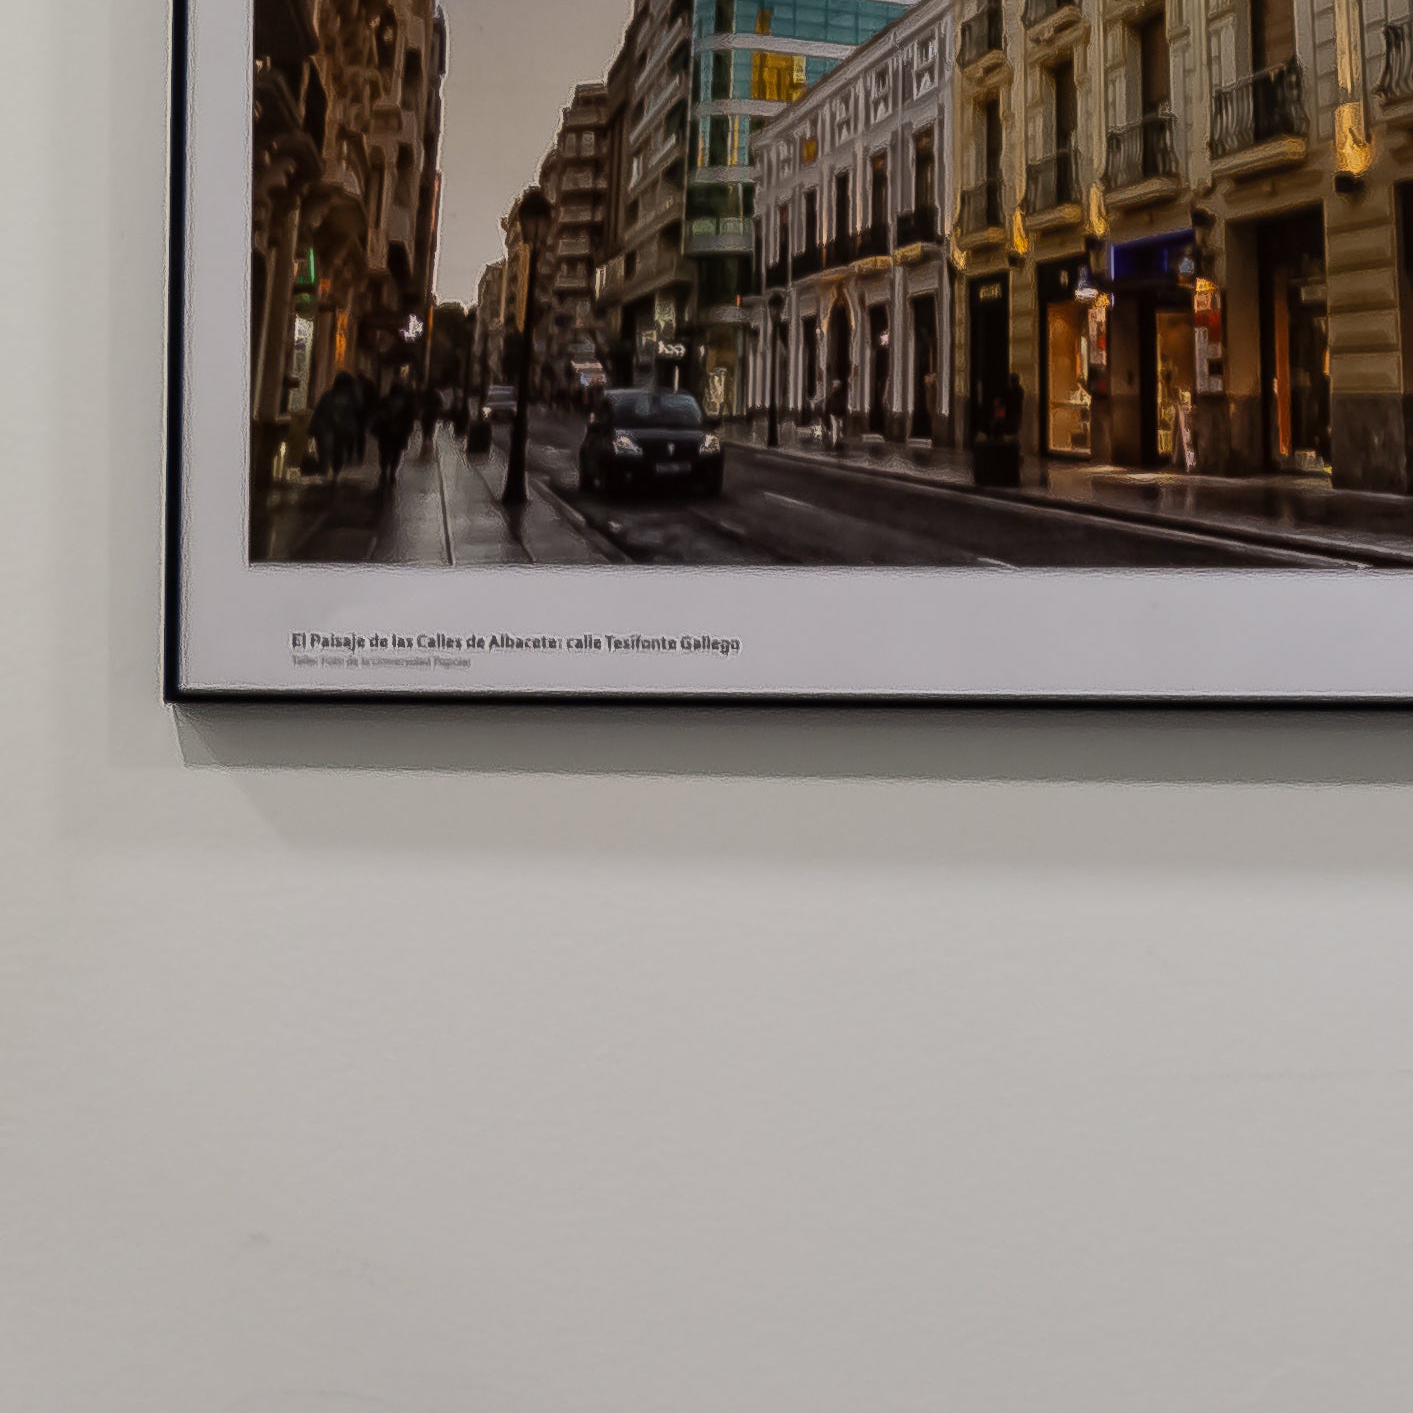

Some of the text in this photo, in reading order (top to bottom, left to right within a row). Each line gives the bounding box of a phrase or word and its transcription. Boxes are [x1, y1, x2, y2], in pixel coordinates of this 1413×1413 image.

[291, 633, 306, 649] El
[310, 633, 365, 654] Paisaje
[369, 633, 389, 649] de
[392, 633, 414, 649] las
[417, 633, 463, 650] Calles
[466, 633, 485, 649] de
[566, 634, 602, 650] calle
[605, 634, 677, 651] Tesifonte
[680, 635, 741, 656] Gallego
